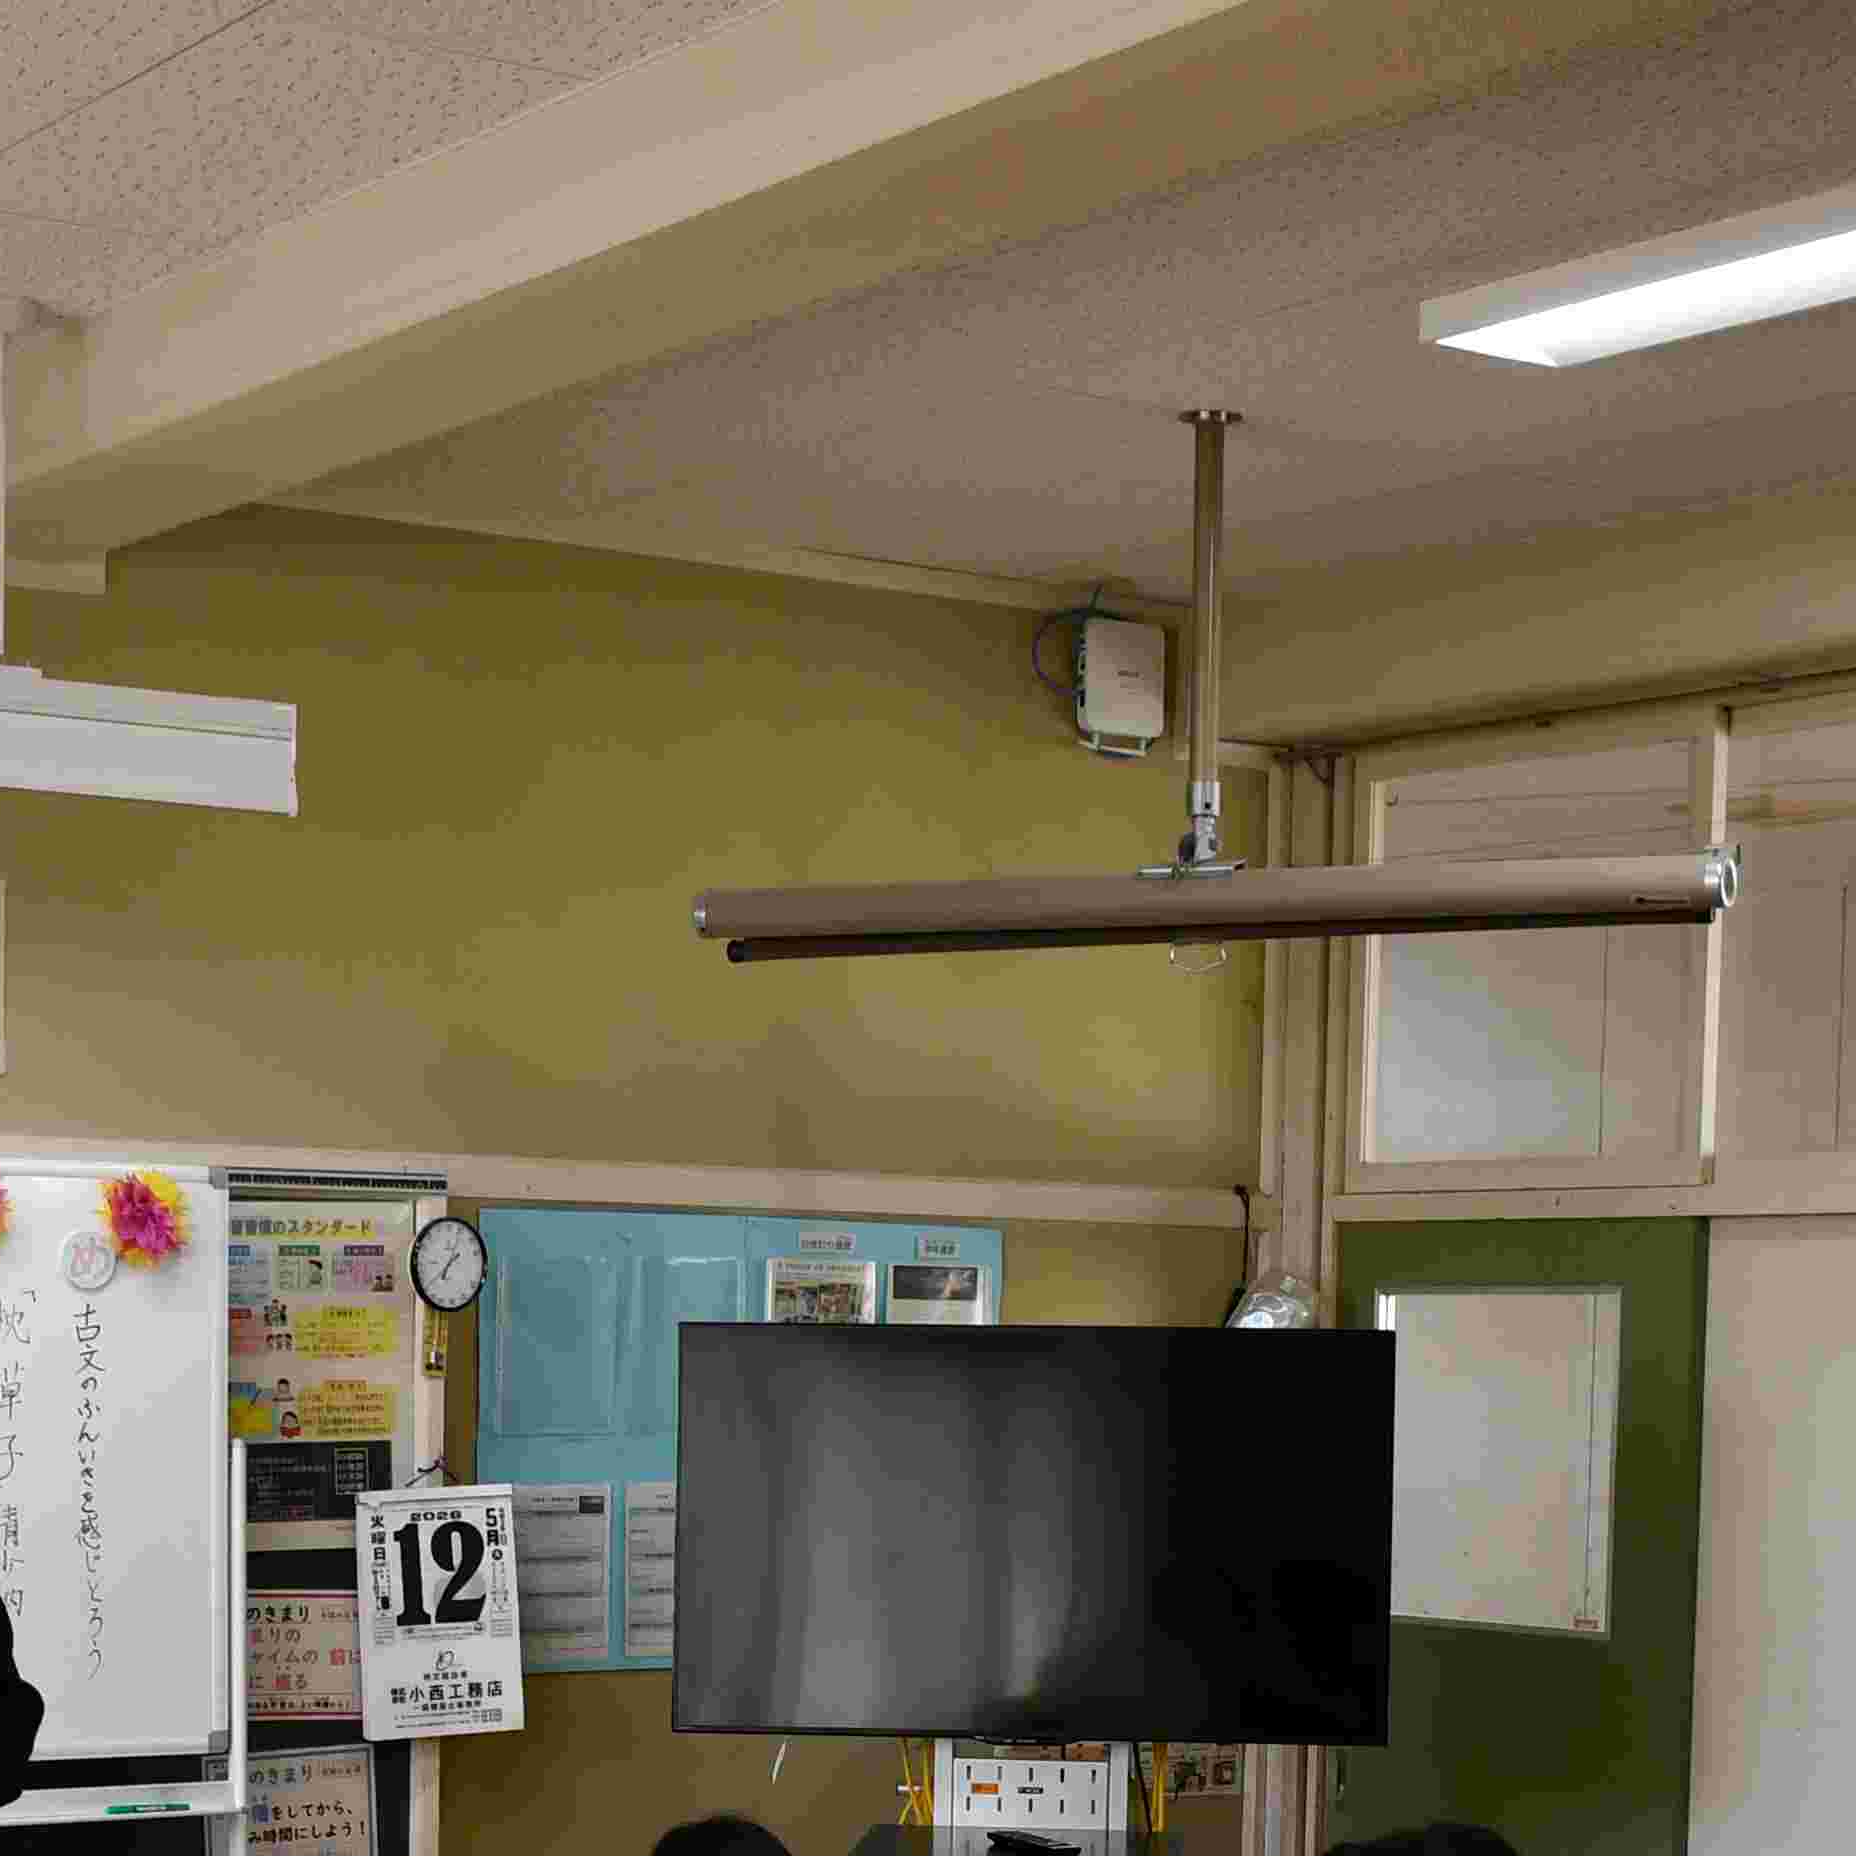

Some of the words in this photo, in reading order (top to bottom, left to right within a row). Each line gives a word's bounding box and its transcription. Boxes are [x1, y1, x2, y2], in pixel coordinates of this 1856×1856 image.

[370, 1514, 386, 1561] 火曜日
[393, 1520, 487, 1627] 12
[409, 1680, 504, 1703] 小西工務店
